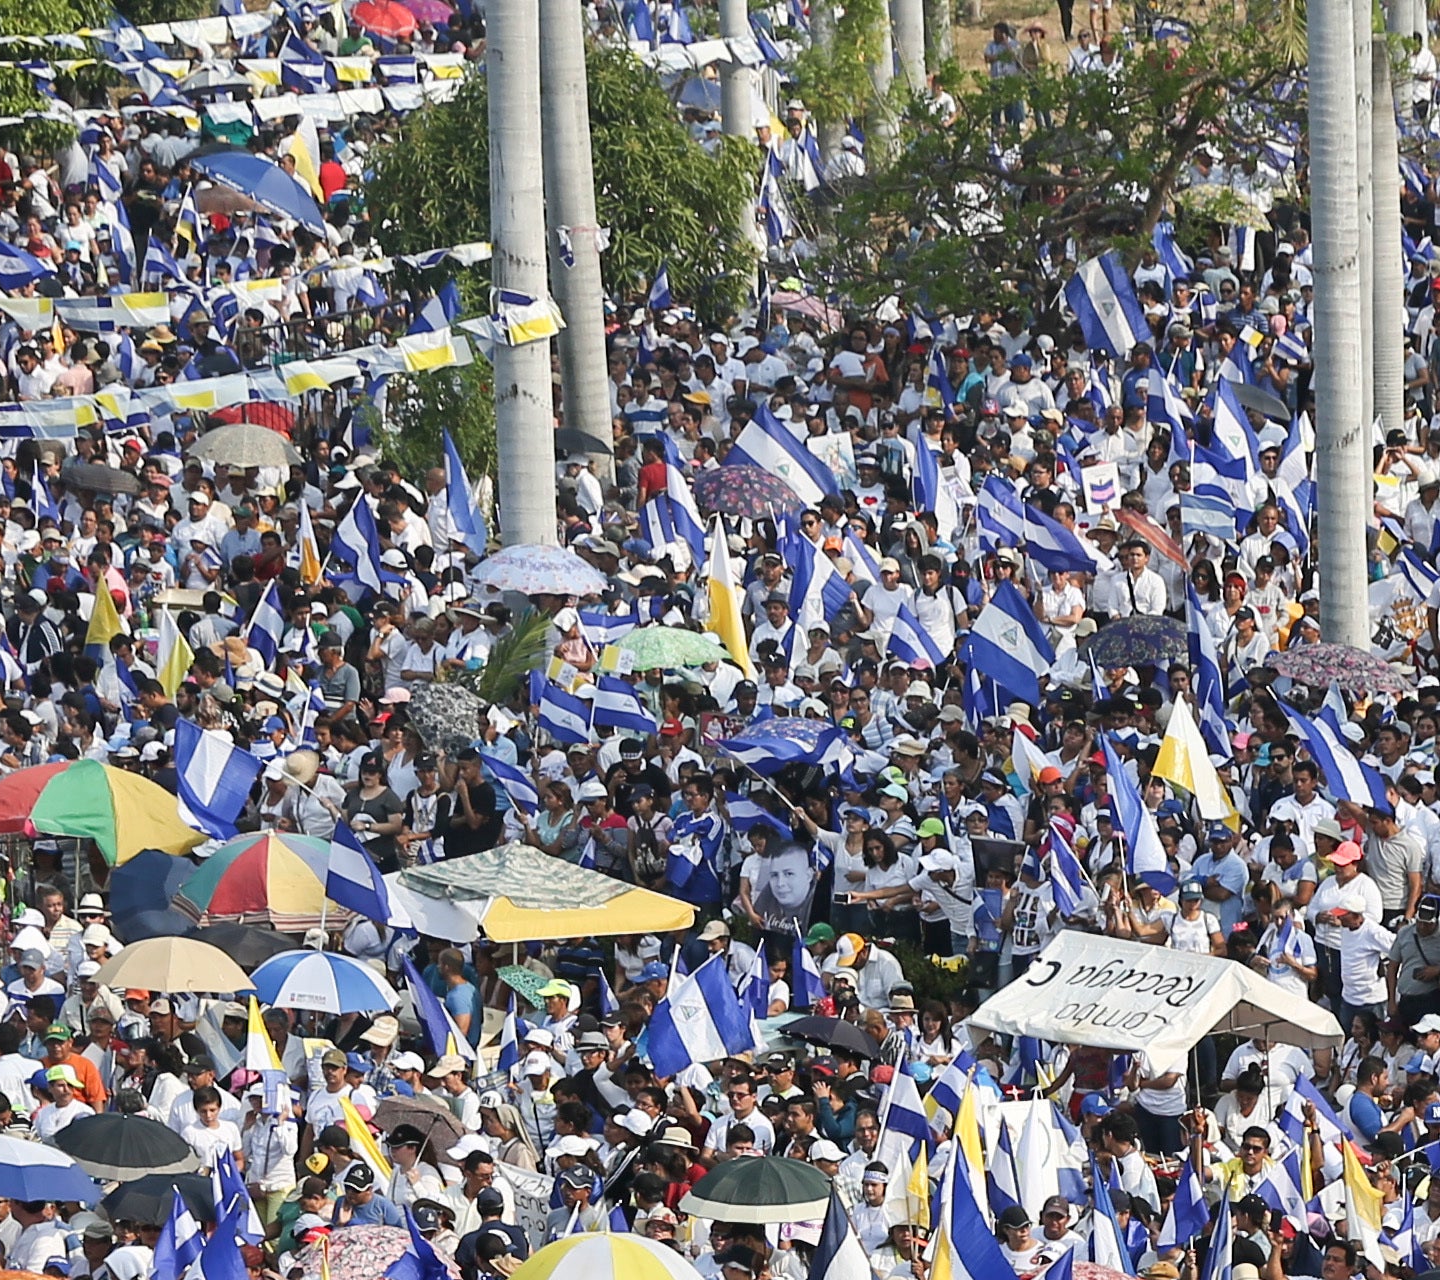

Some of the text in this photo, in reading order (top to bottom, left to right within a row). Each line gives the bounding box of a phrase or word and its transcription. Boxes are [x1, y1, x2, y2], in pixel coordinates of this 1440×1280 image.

[1025, 957, 1206, 1008] Recarga C
[1055, 1003, 1167, 1039] Combo
